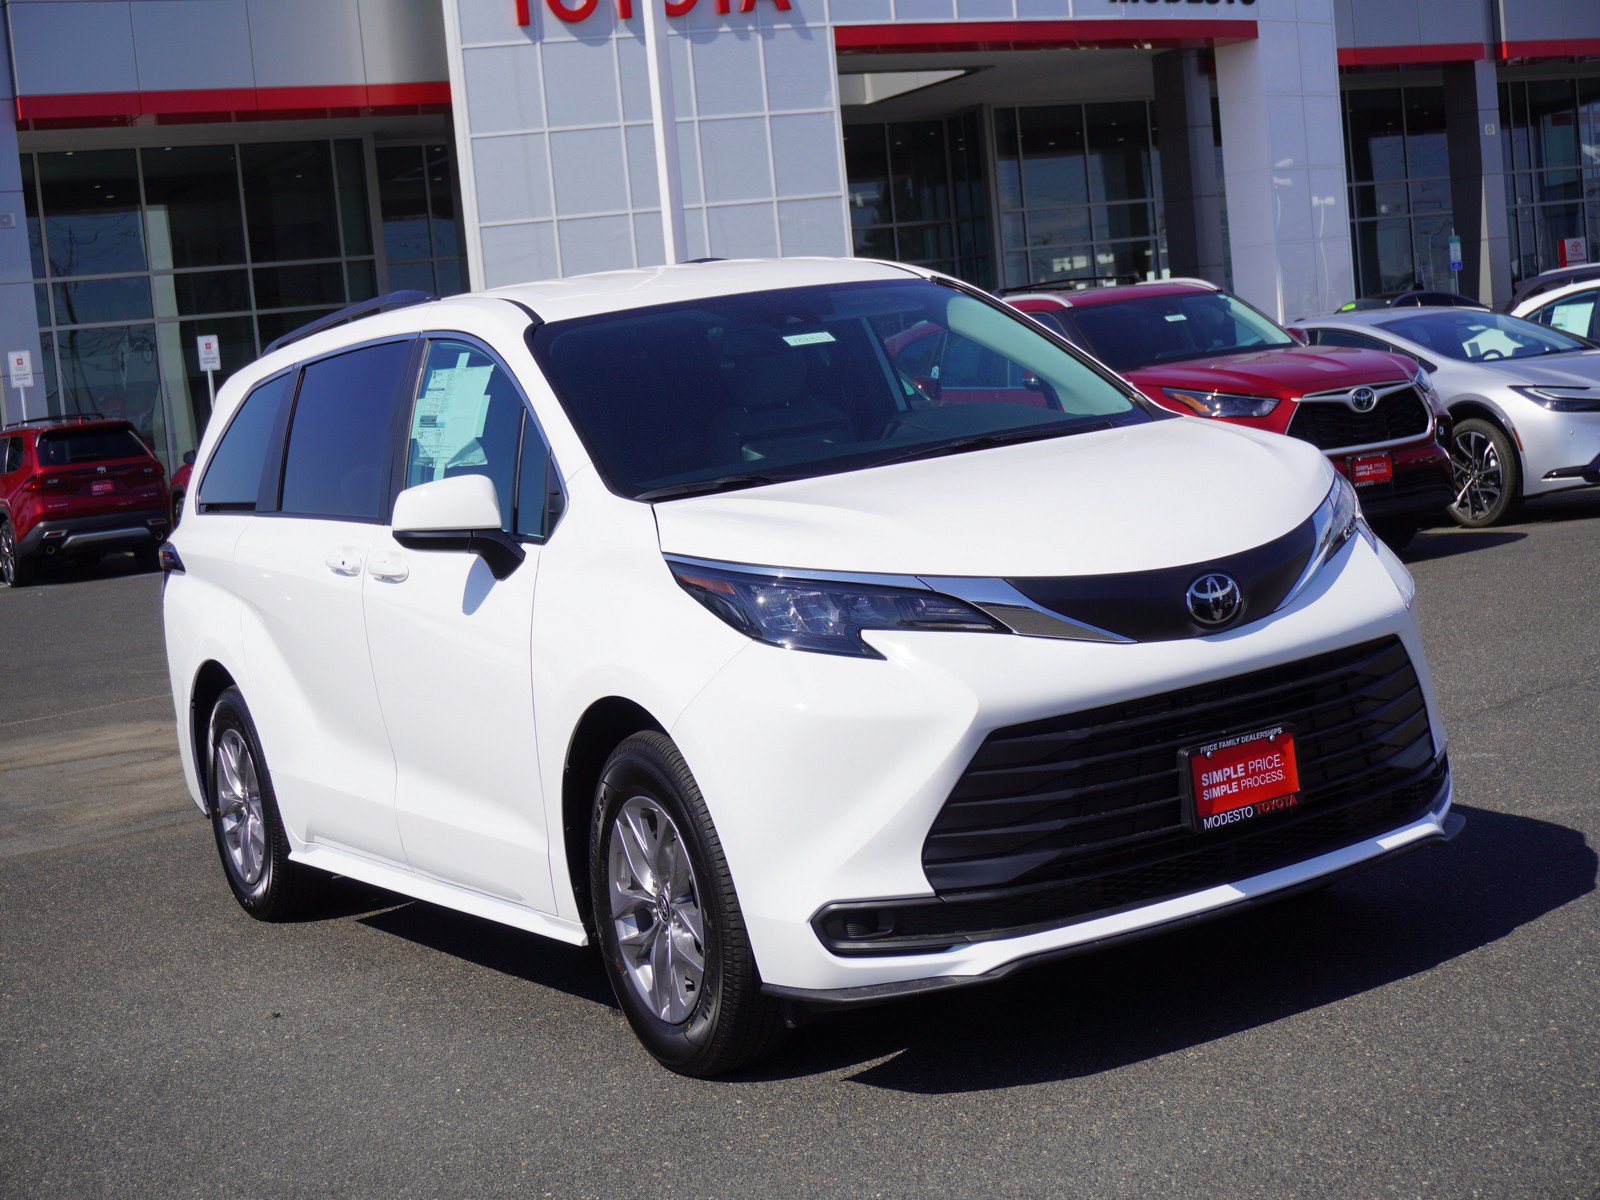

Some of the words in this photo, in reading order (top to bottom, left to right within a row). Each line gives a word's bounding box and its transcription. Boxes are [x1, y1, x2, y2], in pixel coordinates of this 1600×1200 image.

[1200, 743, 1218, 754] PRICE
[1219, 737, 1240, 749] FAMILY
[1241, 727, 1282, 744] DEALERSHIPS
[1201, 763, 1245, 787] SIMPLE
[1248, 754, 1284, 774] PRICE.
[1203, 781, 1238, 801] SIMPLE
[1240, 770, 1286, 791] PROCESS.
[1203, 806, 1253, 830] MODESTO
[1255, 794, 1297, 814] TOYOTA
